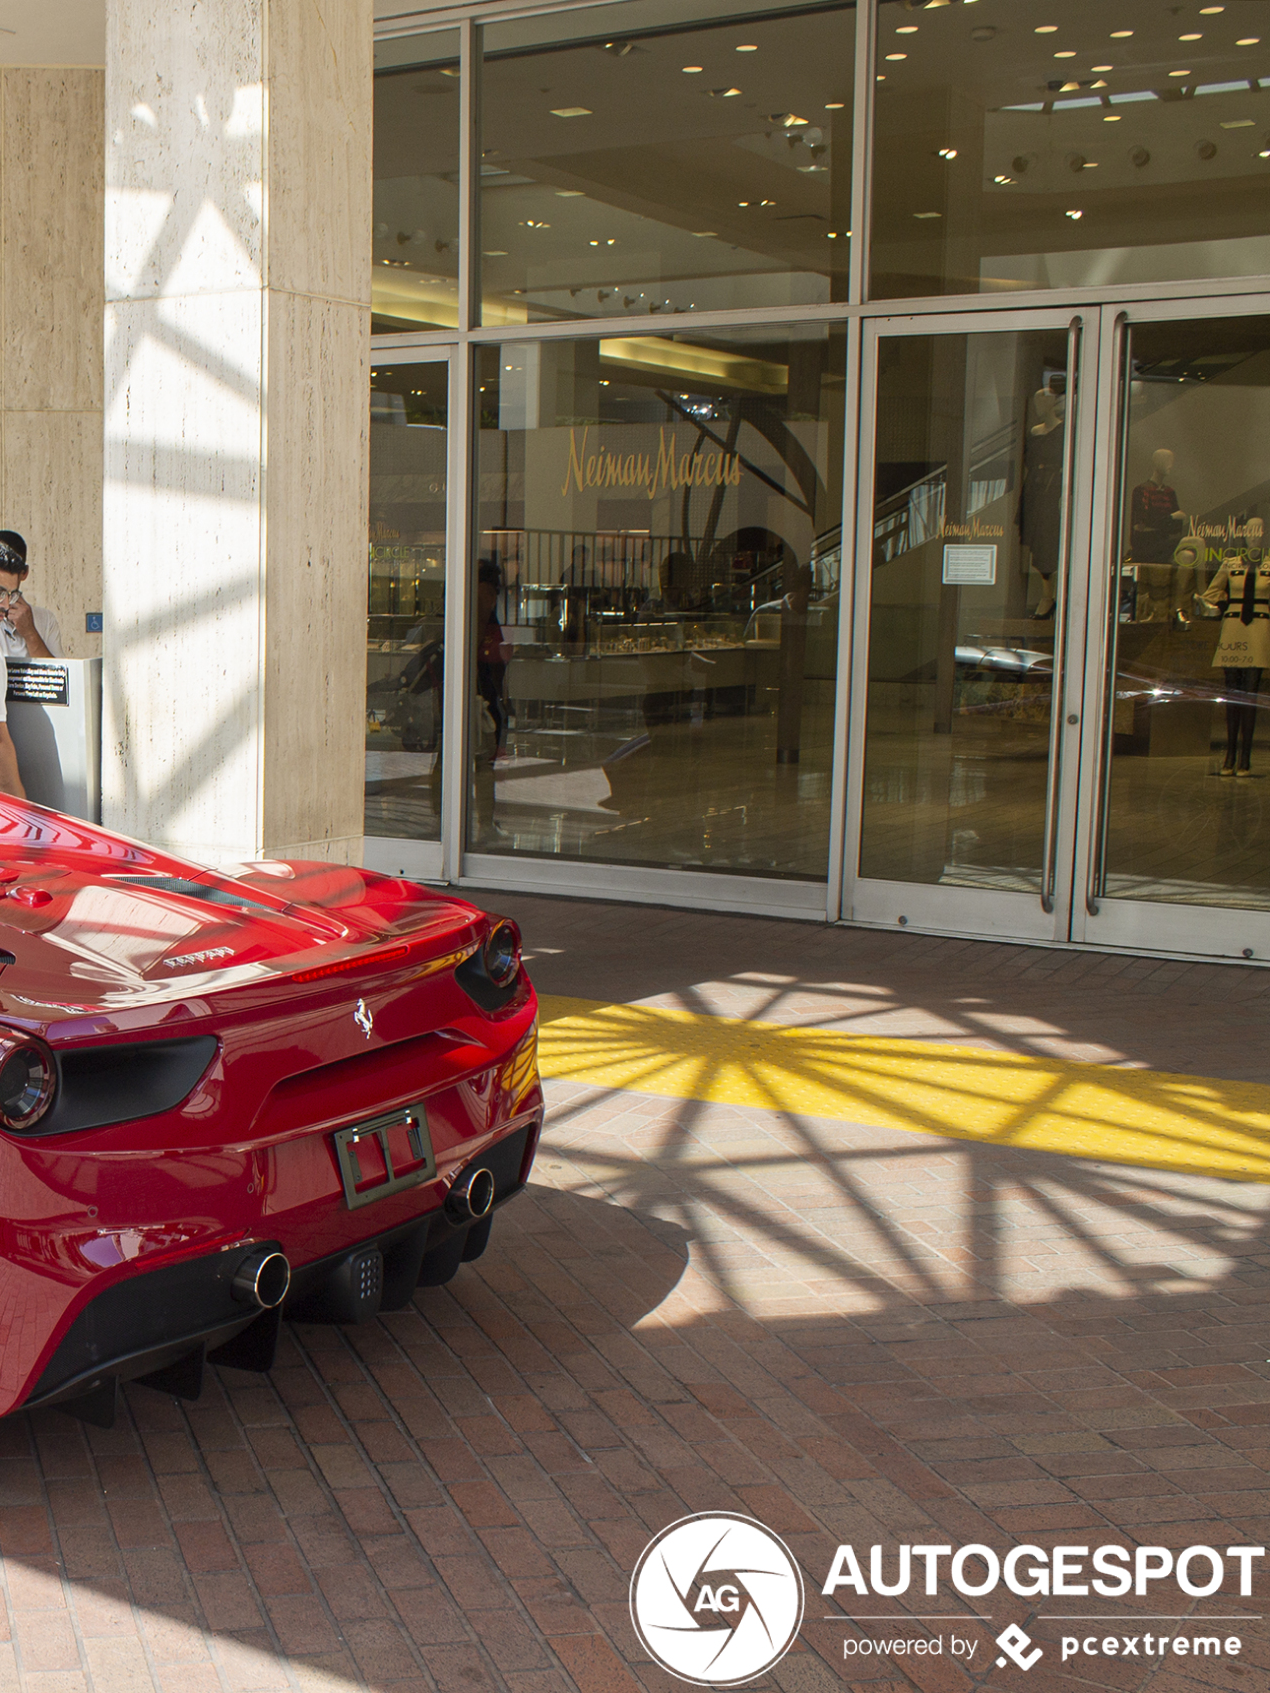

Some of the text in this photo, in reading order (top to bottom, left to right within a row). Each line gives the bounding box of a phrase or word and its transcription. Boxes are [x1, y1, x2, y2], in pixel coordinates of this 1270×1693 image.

[561, 426, 744, 500] Neiman Marcus
[1188, 515, 1264, 543] Neiman Marcus
[1205, 547, 1270, 562] INCIRCL
